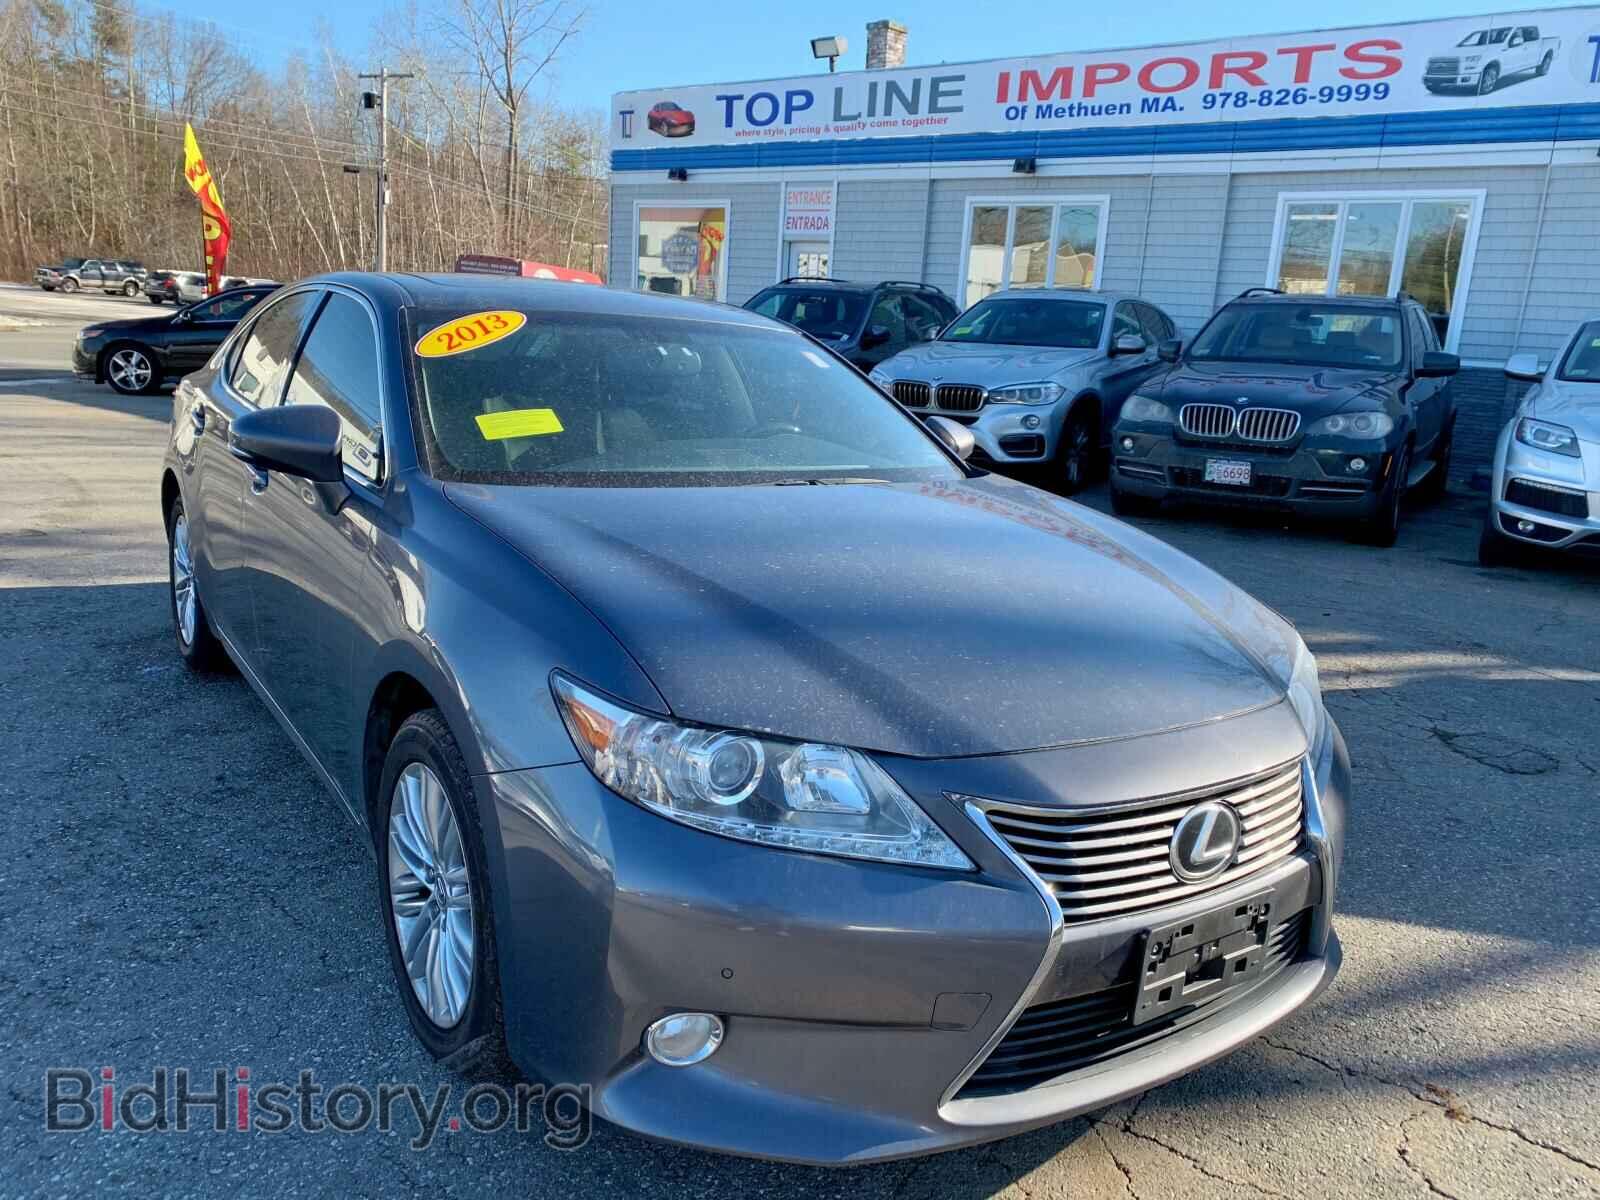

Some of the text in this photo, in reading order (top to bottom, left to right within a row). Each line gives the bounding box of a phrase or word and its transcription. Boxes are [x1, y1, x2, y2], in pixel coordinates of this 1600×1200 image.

[996, 39, 1403, 104] IMPORTS
[716, 89, 814, 128] TOP
[832, 74, 966, 122] LINE
[1005, 82, 1390, 121] Of Methuen MA. 978-826-9999
[735, 116, 949, 137] where style, pricing & quality come together
[787, 191, 832, 206] ENTRANCE
[785, 216, 830, 231] ENTRADA
[436, 314, 509, 351] 2013
